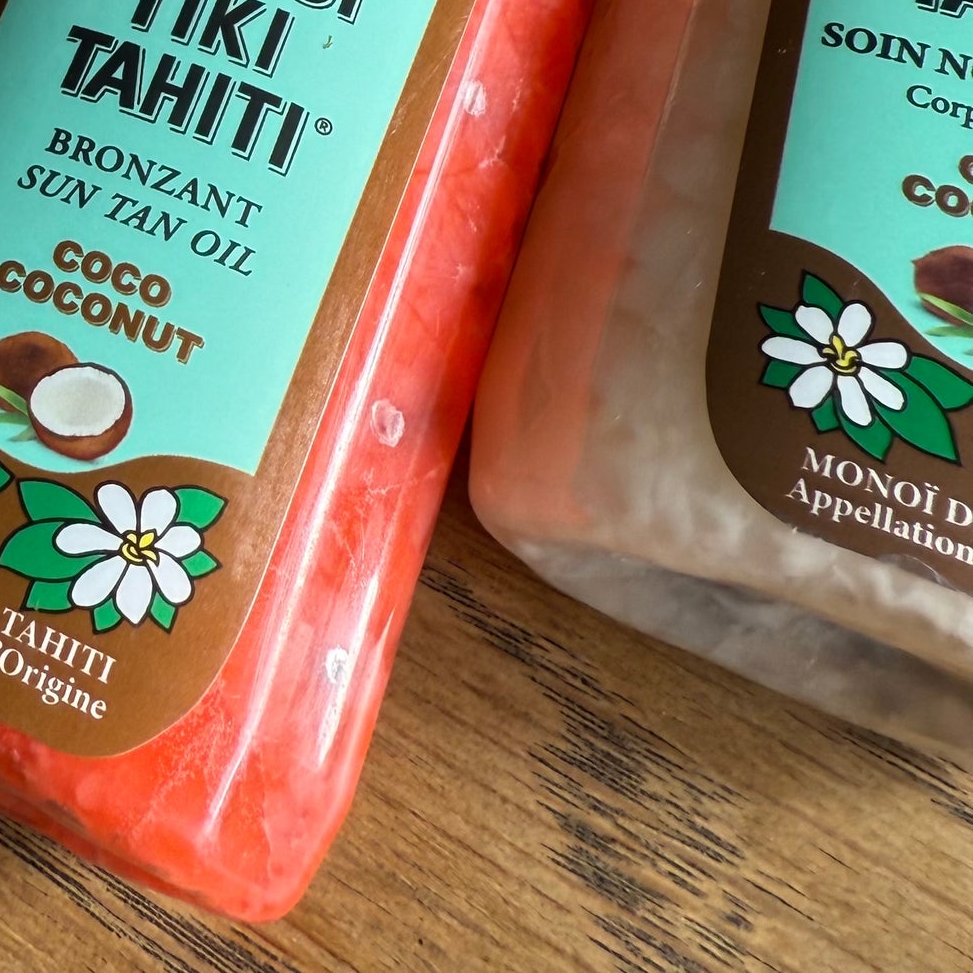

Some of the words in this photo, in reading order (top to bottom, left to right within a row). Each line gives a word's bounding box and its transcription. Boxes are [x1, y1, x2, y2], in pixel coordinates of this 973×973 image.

[821, 22, 931, 69] SOIN
[44, 127, 264, 228] BRONZANT
[17, 164, 103, 210] SUN
[103, 192, 188, 242] TAN
[189, 229, 256, 277] OIL
[52, 239, 172, 308] COCO
[801, 446, 940, 515] MONOÏ
[785, 478, 973, 566] Appellation
